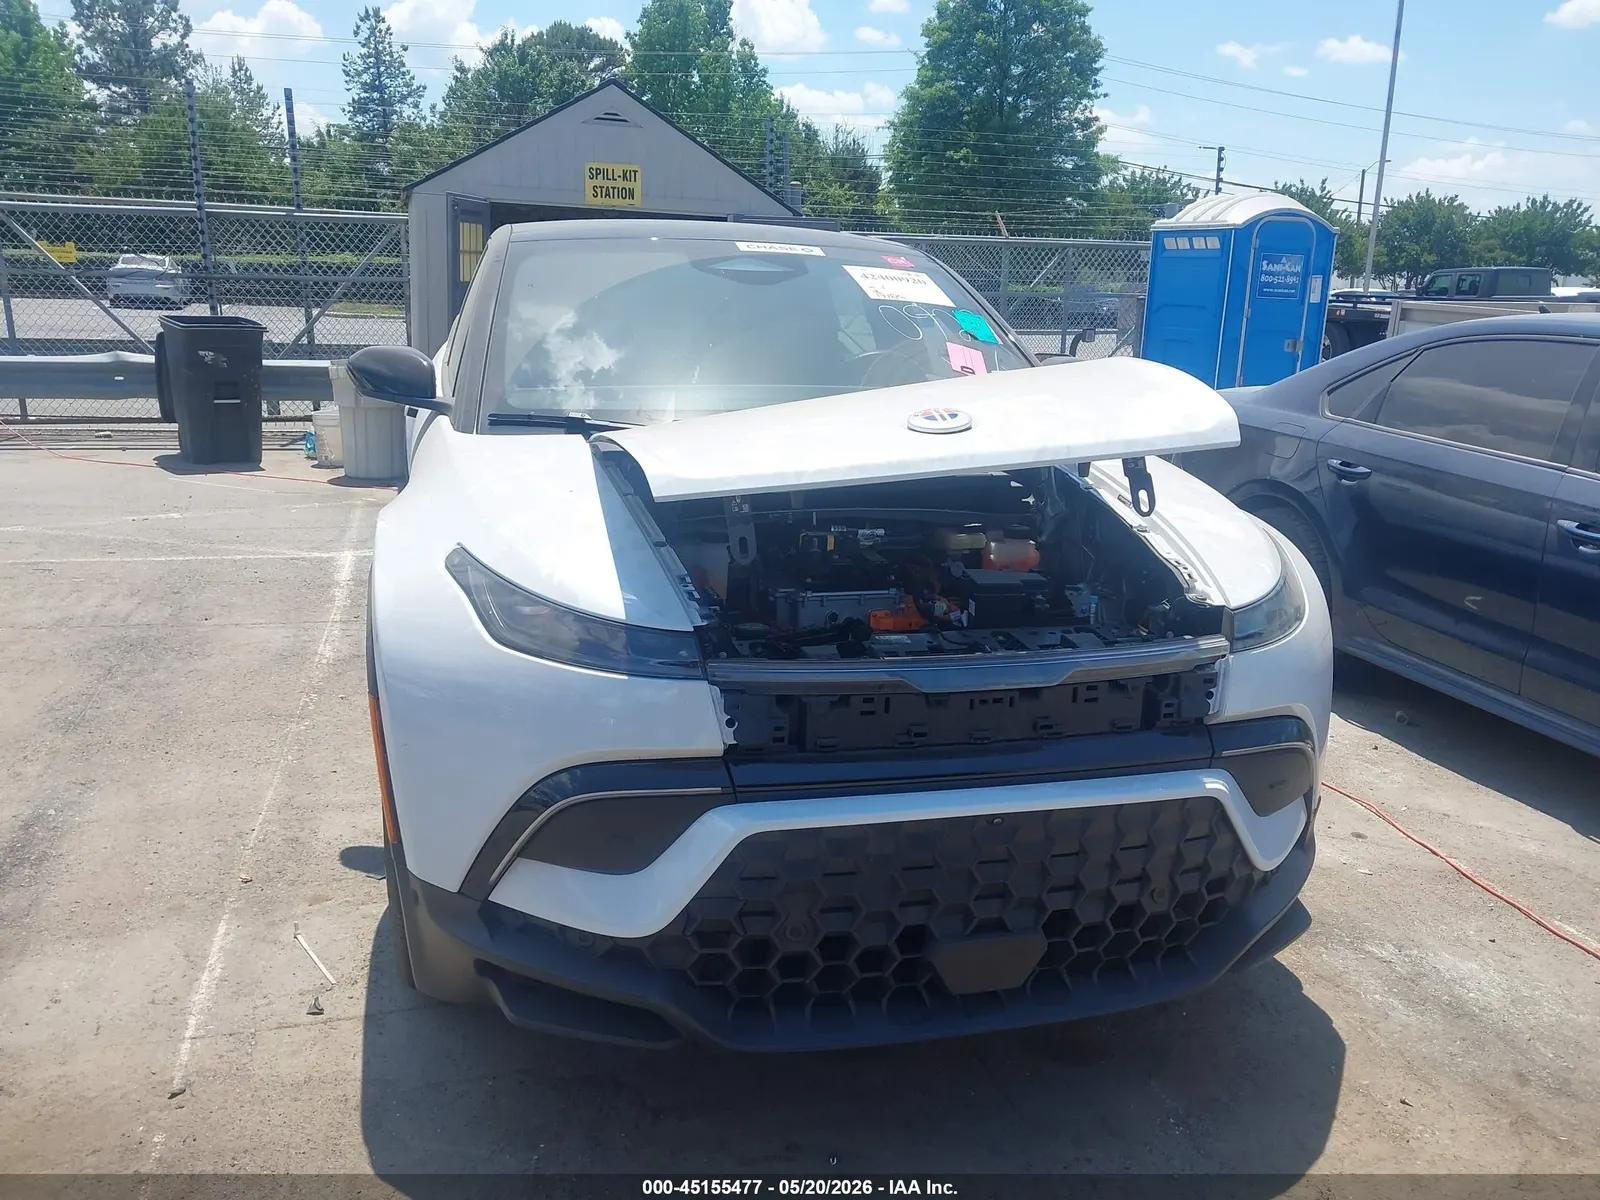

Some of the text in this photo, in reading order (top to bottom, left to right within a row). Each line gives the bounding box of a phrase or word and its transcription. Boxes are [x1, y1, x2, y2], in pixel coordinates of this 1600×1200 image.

[588, 166, 638, 182] SPILL-KIT
[592, 184, 635, 200] STATION
[746, 243, 797, 252] CHASE
